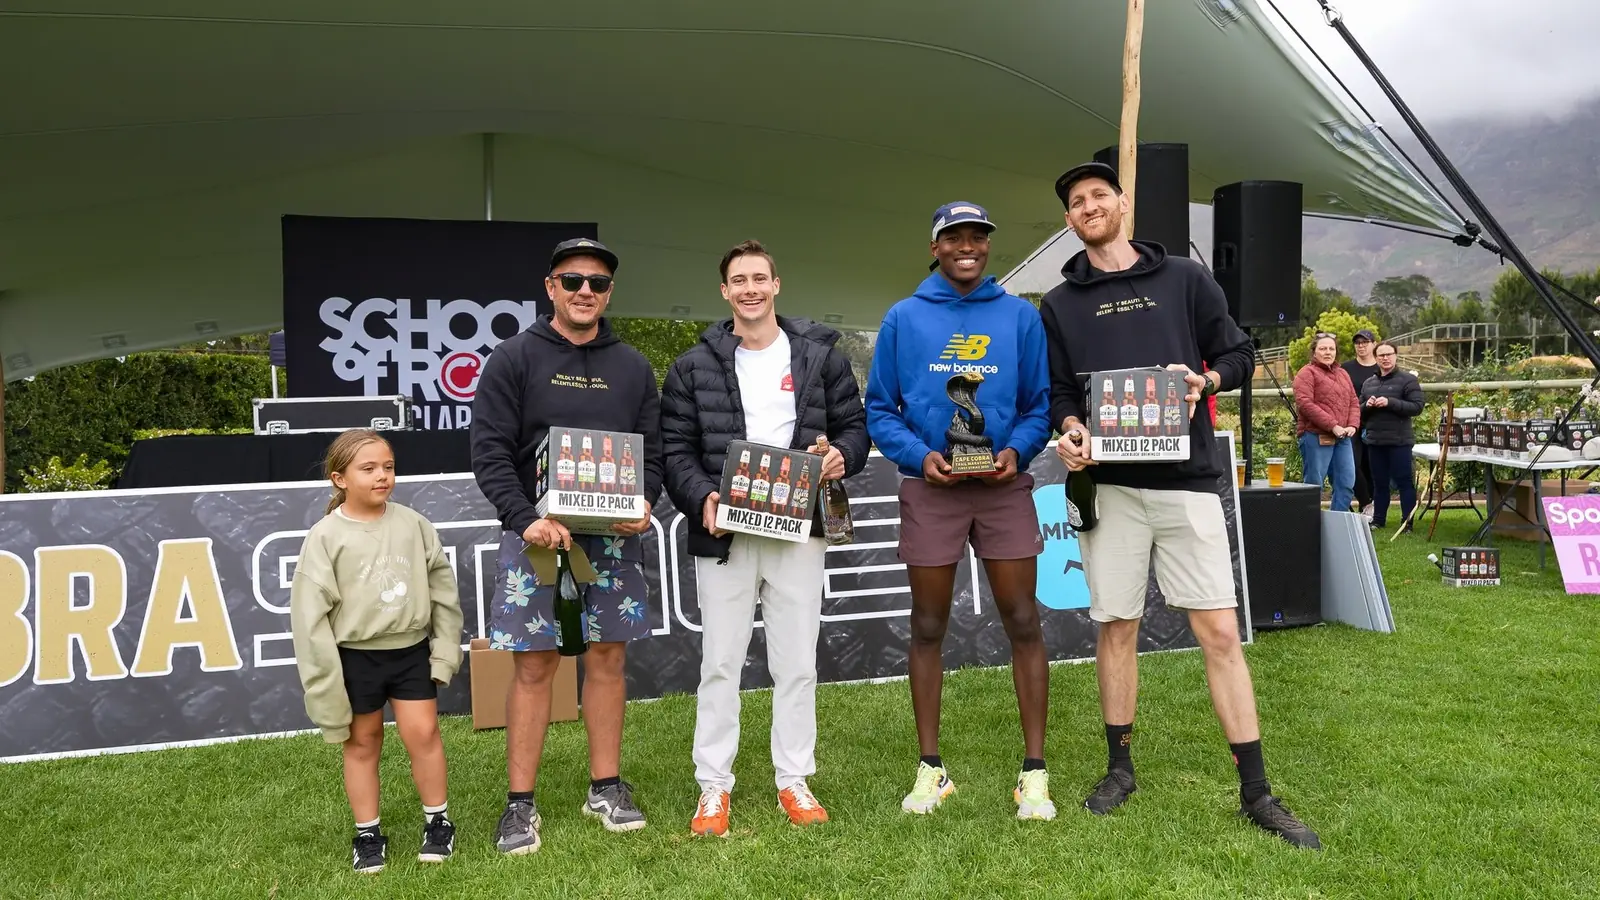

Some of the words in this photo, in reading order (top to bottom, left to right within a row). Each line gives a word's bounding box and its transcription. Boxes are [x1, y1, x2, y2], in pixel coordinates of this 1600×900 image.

[929, 363, 952, 372] new
[953, 362, 998, 374] balance
[1102, 438, 1137, 452] MIXED
[1140, 439, 1149, 451] 12
[1152, 438, 1180, 452] PACK
[558, 493, 594, 507] MIXED
[597, 495, 606, 508] 12
[608, 496, 635, 510] PACK
[726, 508, 761, 527] MIXED
[763, 515, 773, 529] 12
[774, 517, 803, 534] PACK
[1548, 502, 1600, 530] Spo
[1578, 543, 1600, 576] R
